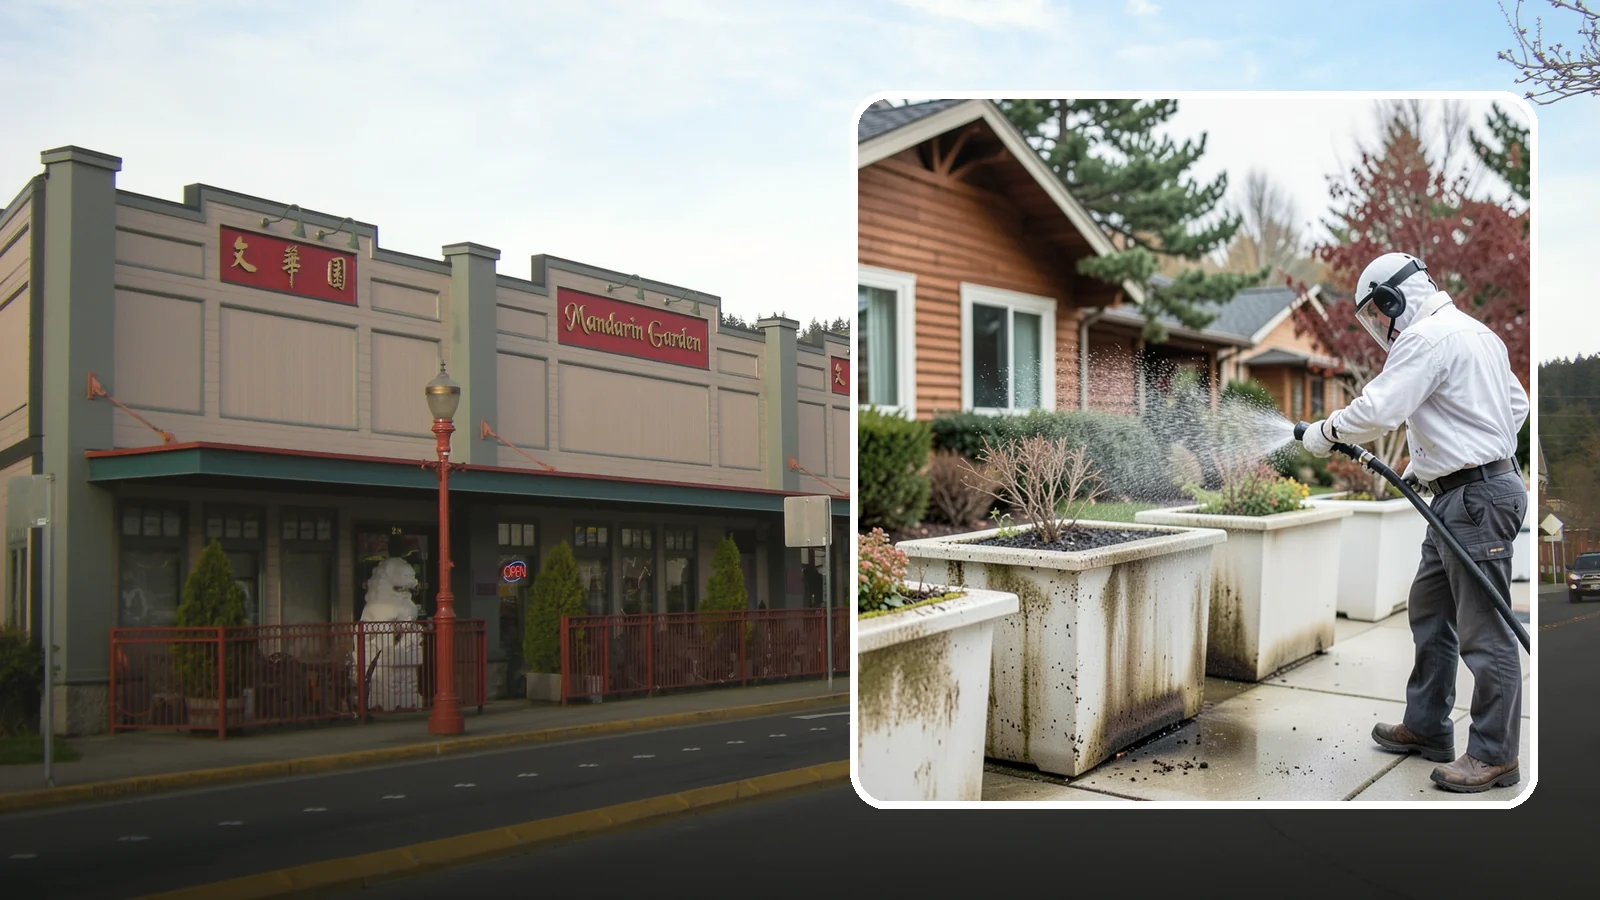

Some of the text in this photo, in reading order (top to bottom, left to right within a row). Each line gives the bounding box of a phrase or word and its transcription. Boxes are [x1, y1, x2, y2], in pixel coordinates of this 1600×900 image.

[231, 236, 346, 290] 文華園
[564, 302, 701, 352] Mandarin Garden
[835, 363, 846, 386] 文
[503, 565, 527, 578] OPEN
